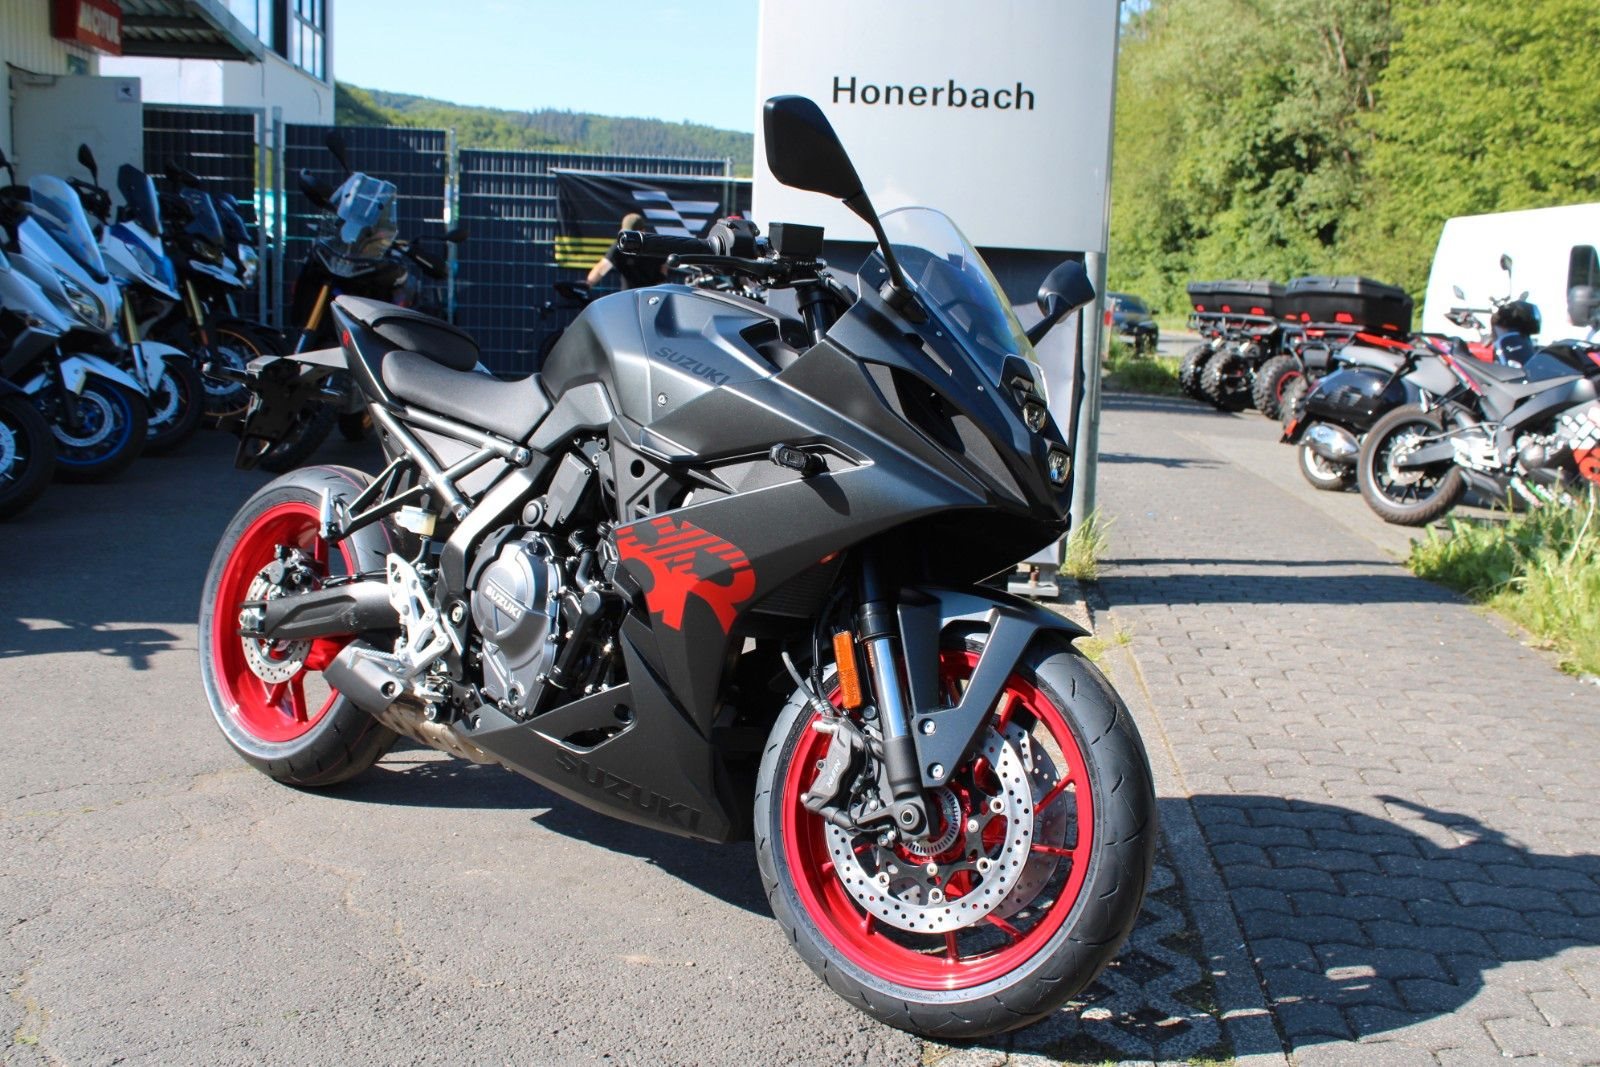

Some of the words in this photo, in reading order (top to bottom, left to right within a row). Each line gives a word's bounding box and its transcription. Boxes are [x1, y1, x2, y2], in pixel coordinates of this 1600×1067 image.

[833, 76, 1034, 110] Honerbach
[655, 346, 730, 386] SUZUKI
[485, 585, 522, 619] SUZUKI
[555, 748, 704, 830] SUZUKI
